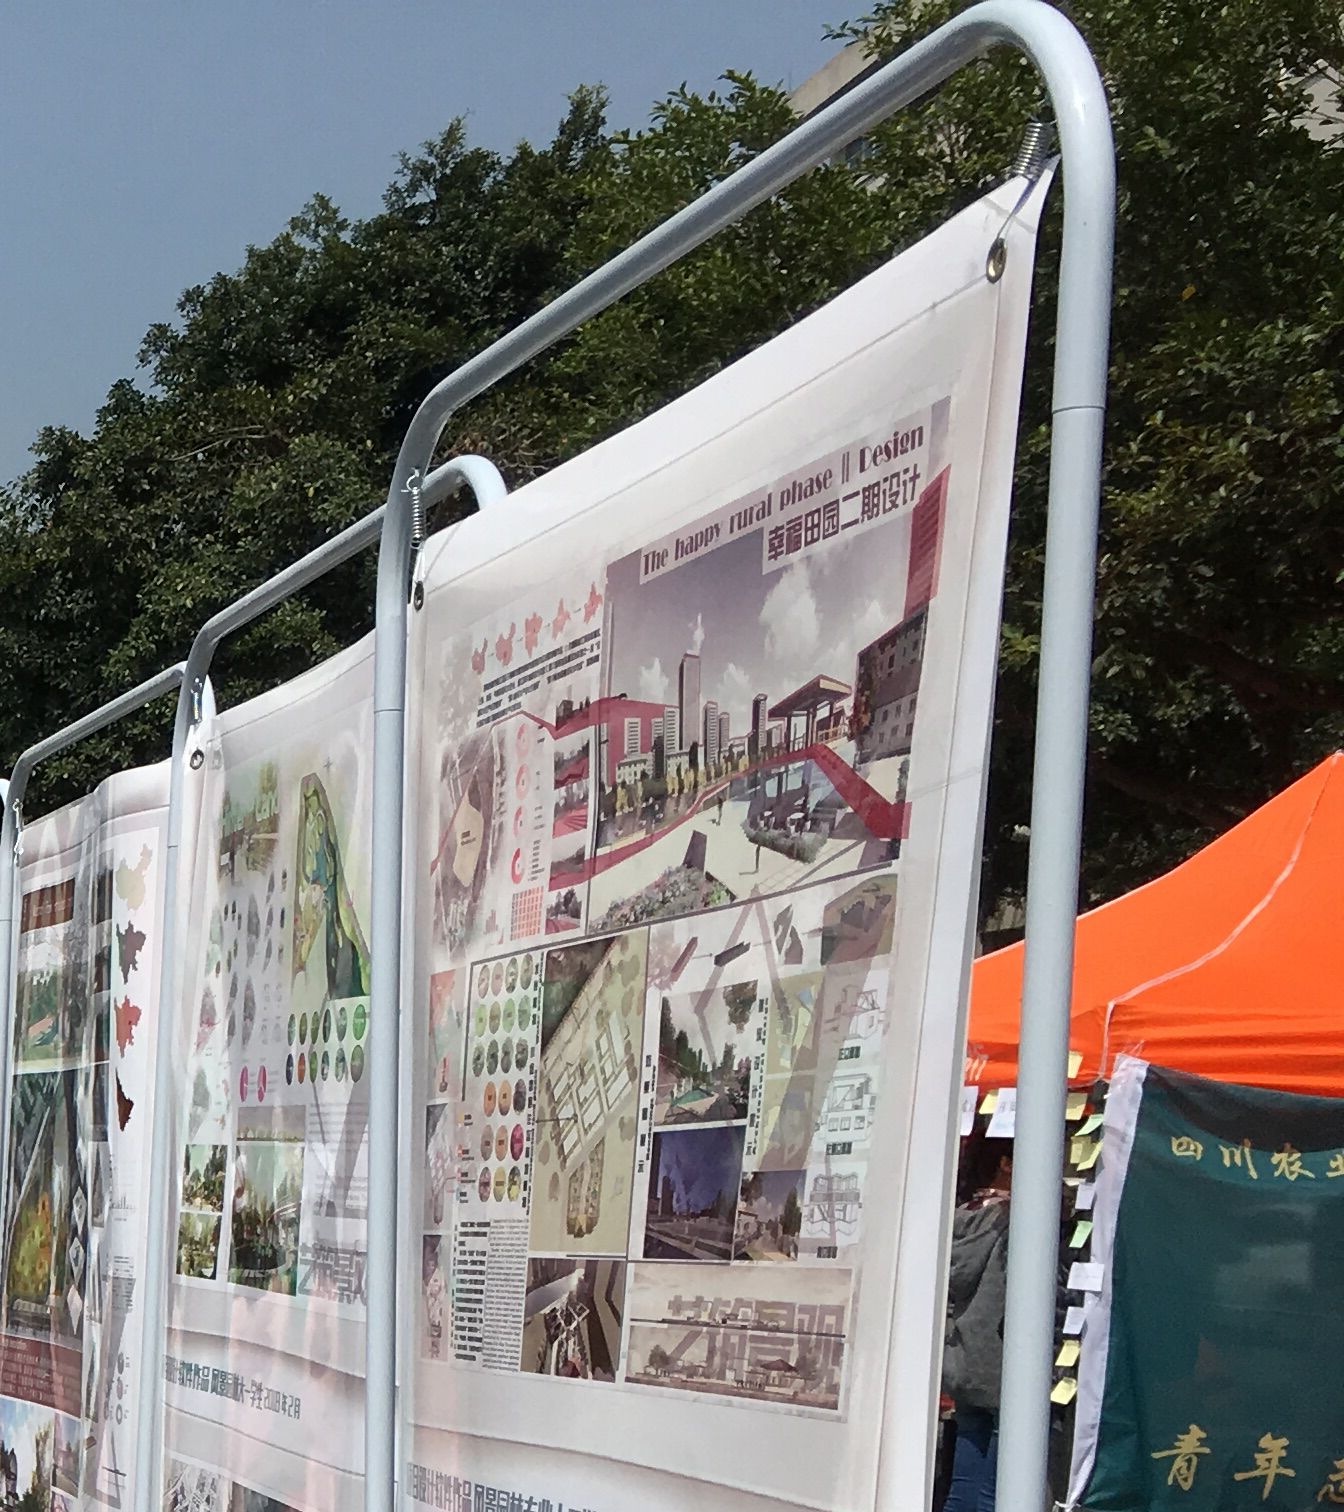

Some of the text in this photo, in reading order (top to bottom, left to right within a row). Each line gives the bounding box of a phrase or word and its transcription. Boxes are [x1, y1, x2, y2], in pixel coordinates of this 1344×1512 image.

[642, 546, 669, 576] The
[676, 524, 722, 561] happy
[728, 495, 771, 535] rural
[779, 467, 833, 513] phase
[859, 425, 924, 473] Design
[767, 464, 922, 563] 幸福田园二期设计
